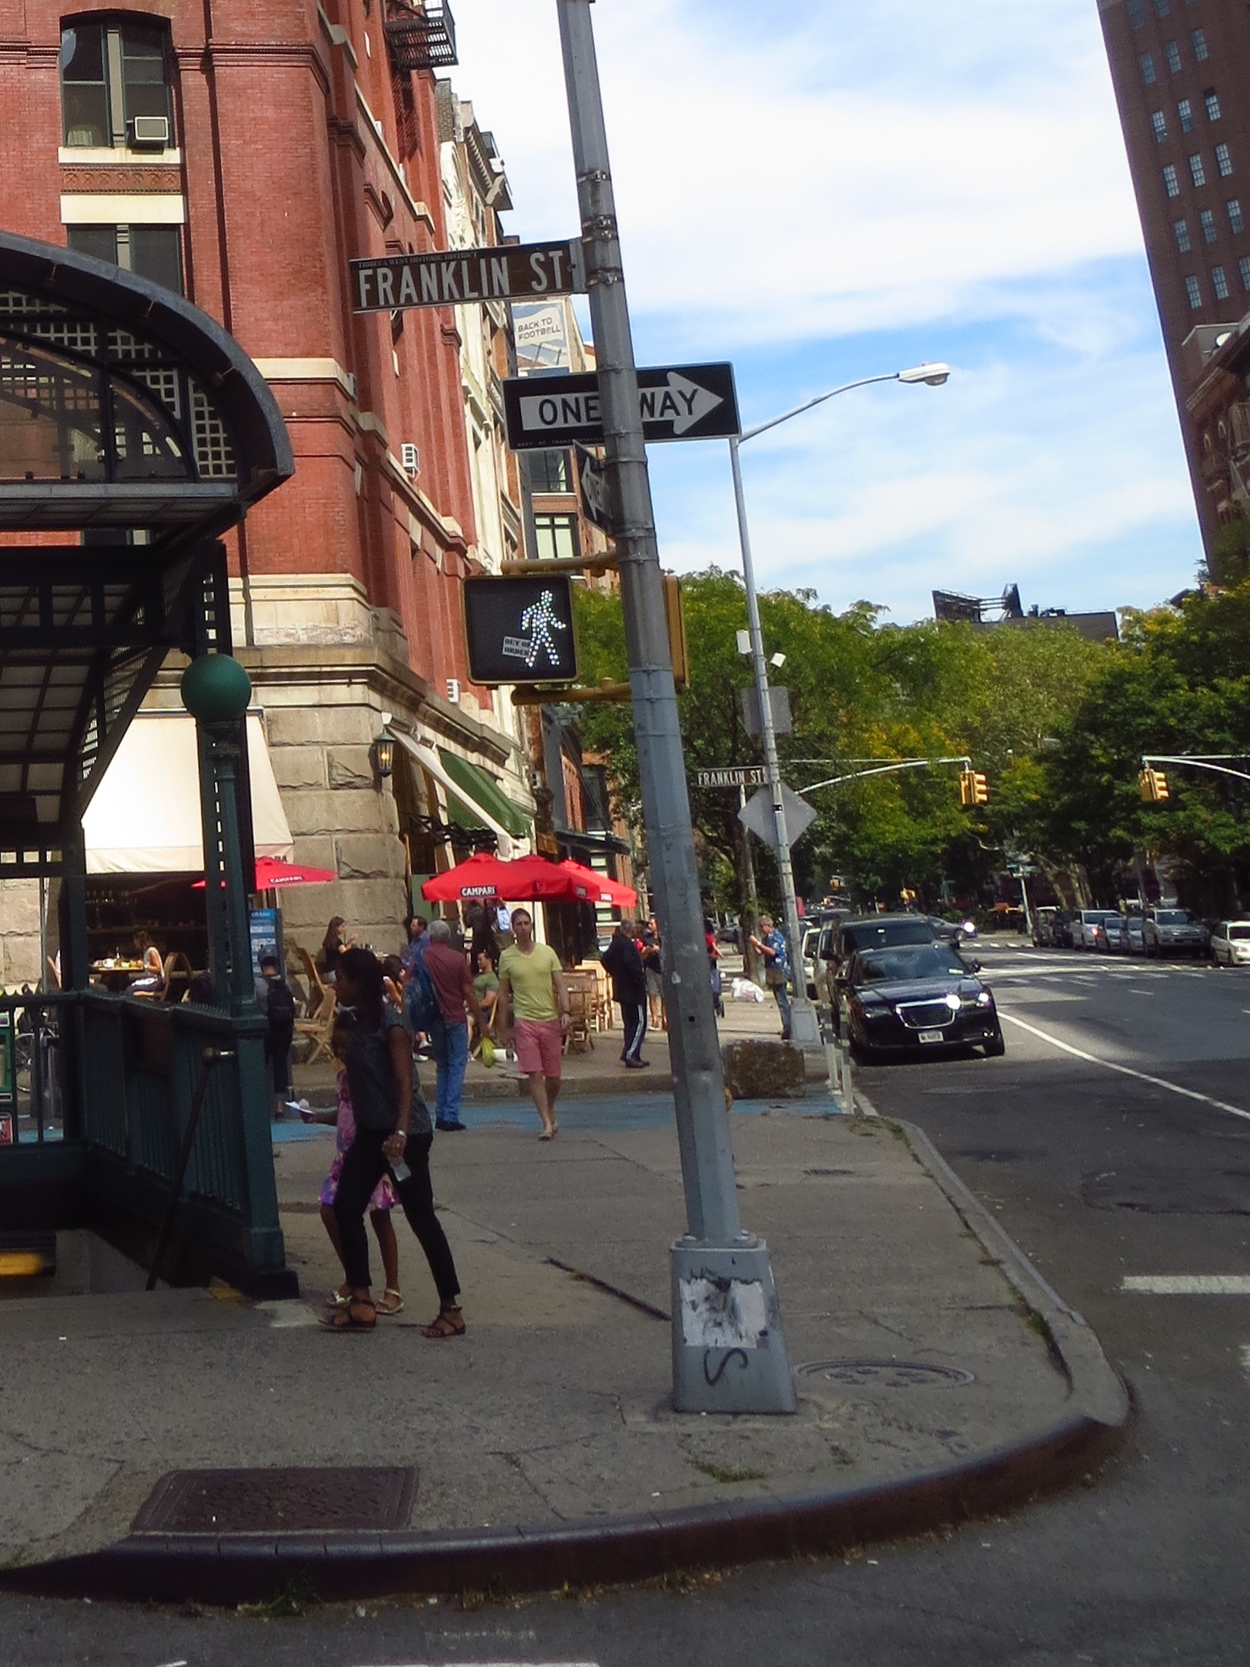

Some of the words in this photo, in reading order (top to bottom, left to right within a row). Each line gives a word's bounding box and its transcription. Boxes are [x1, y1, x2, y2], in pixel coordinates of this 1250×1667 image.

[358, 256, 510, 308] FRANKLIN
[530, 250, 564, 292] ST
[518, 320, 540, 333] BACK
[541, 316, 553, 328] TO
[538, 395, 602, 425] ONE
[505, 638, 519, 646] OUT
[698, 770, 745, 786] FRANKLIN
[750, 769, 762, 784] ST
[461, 886, 496, 897] CAMPARI
